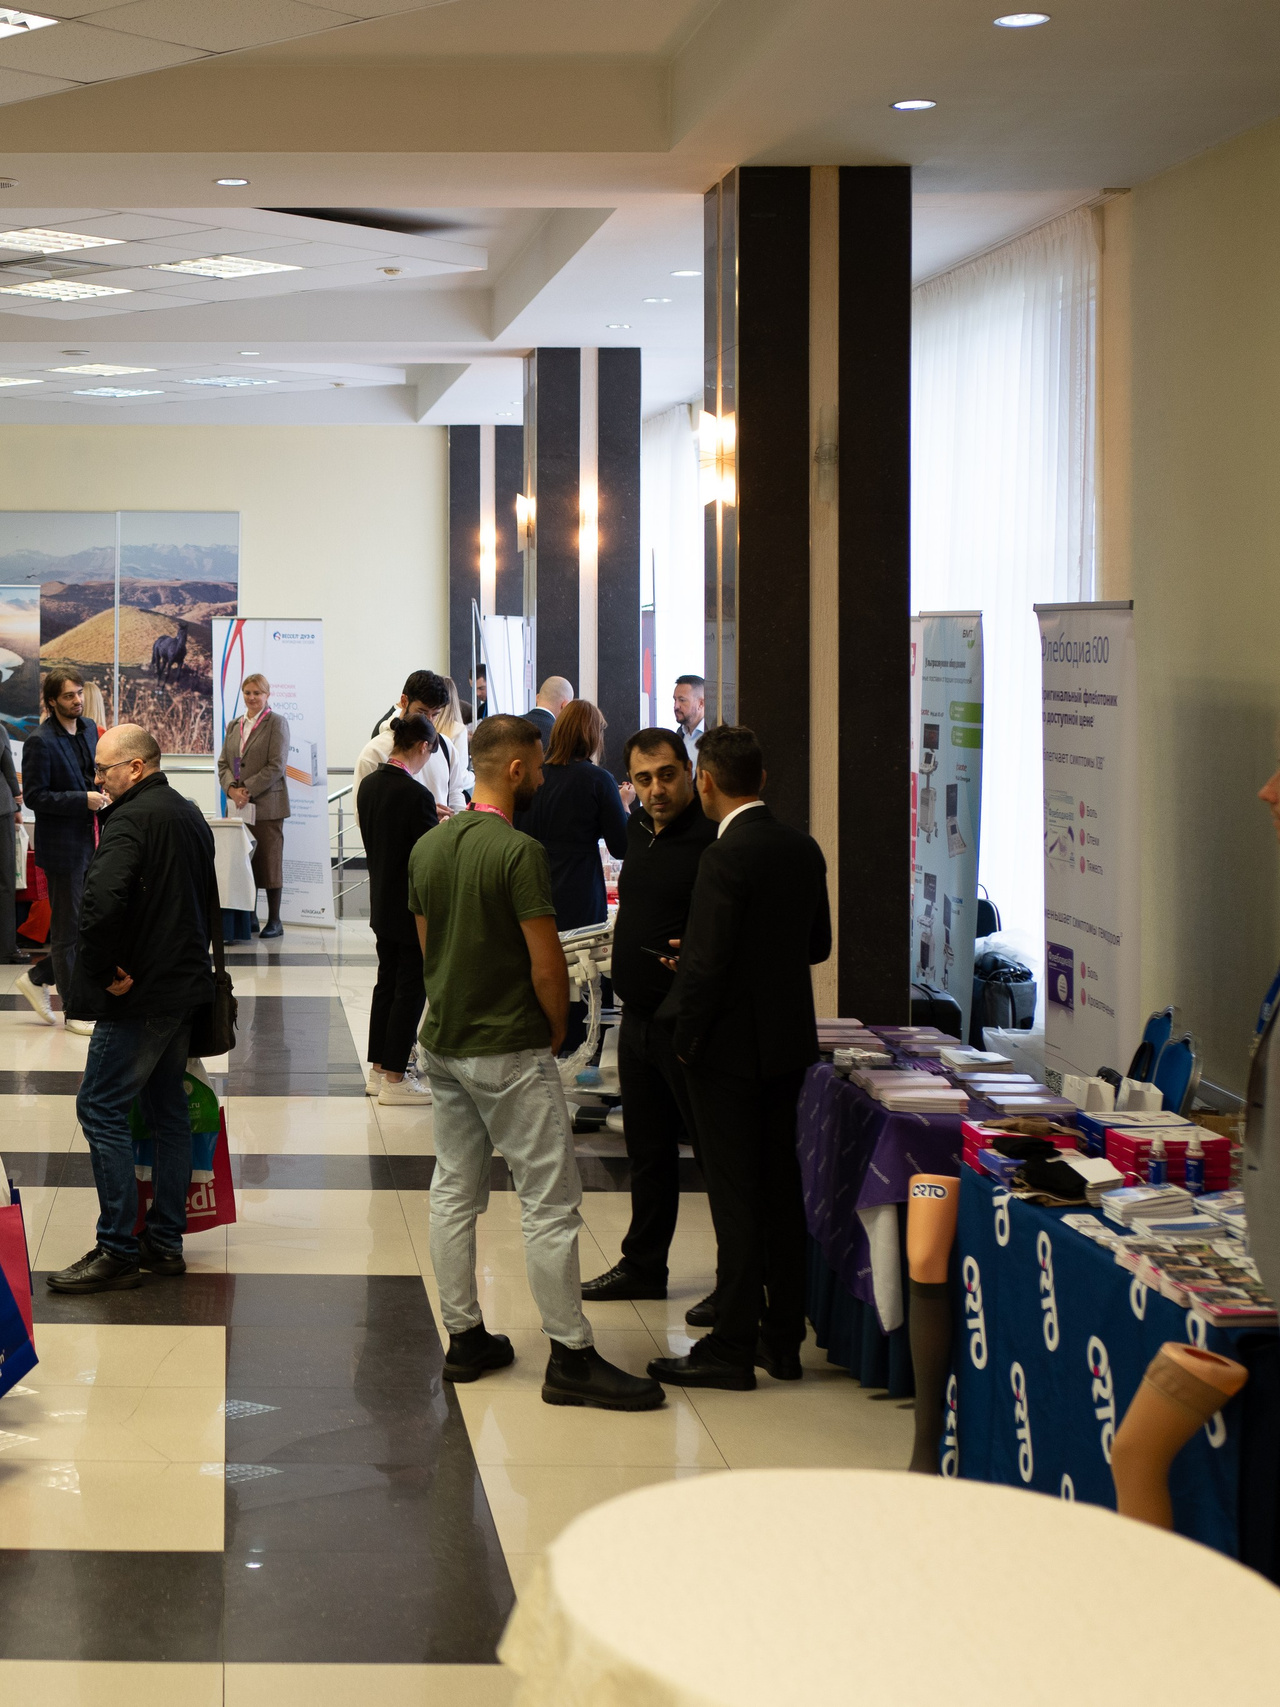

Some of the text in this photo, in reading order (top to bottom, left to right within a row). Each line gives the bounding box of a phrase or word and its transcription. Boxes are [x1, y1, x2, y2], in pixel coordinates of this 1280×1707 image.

[1044, 748, 1069, 764] блегчает
[1045, 908, 1071, 925] еньшает
[962, 1255, 988, 1370] ORTO
[1036, 1230, 1060, 1352] ORTO
[1010, 1361, 1033, 1483] ORTO
